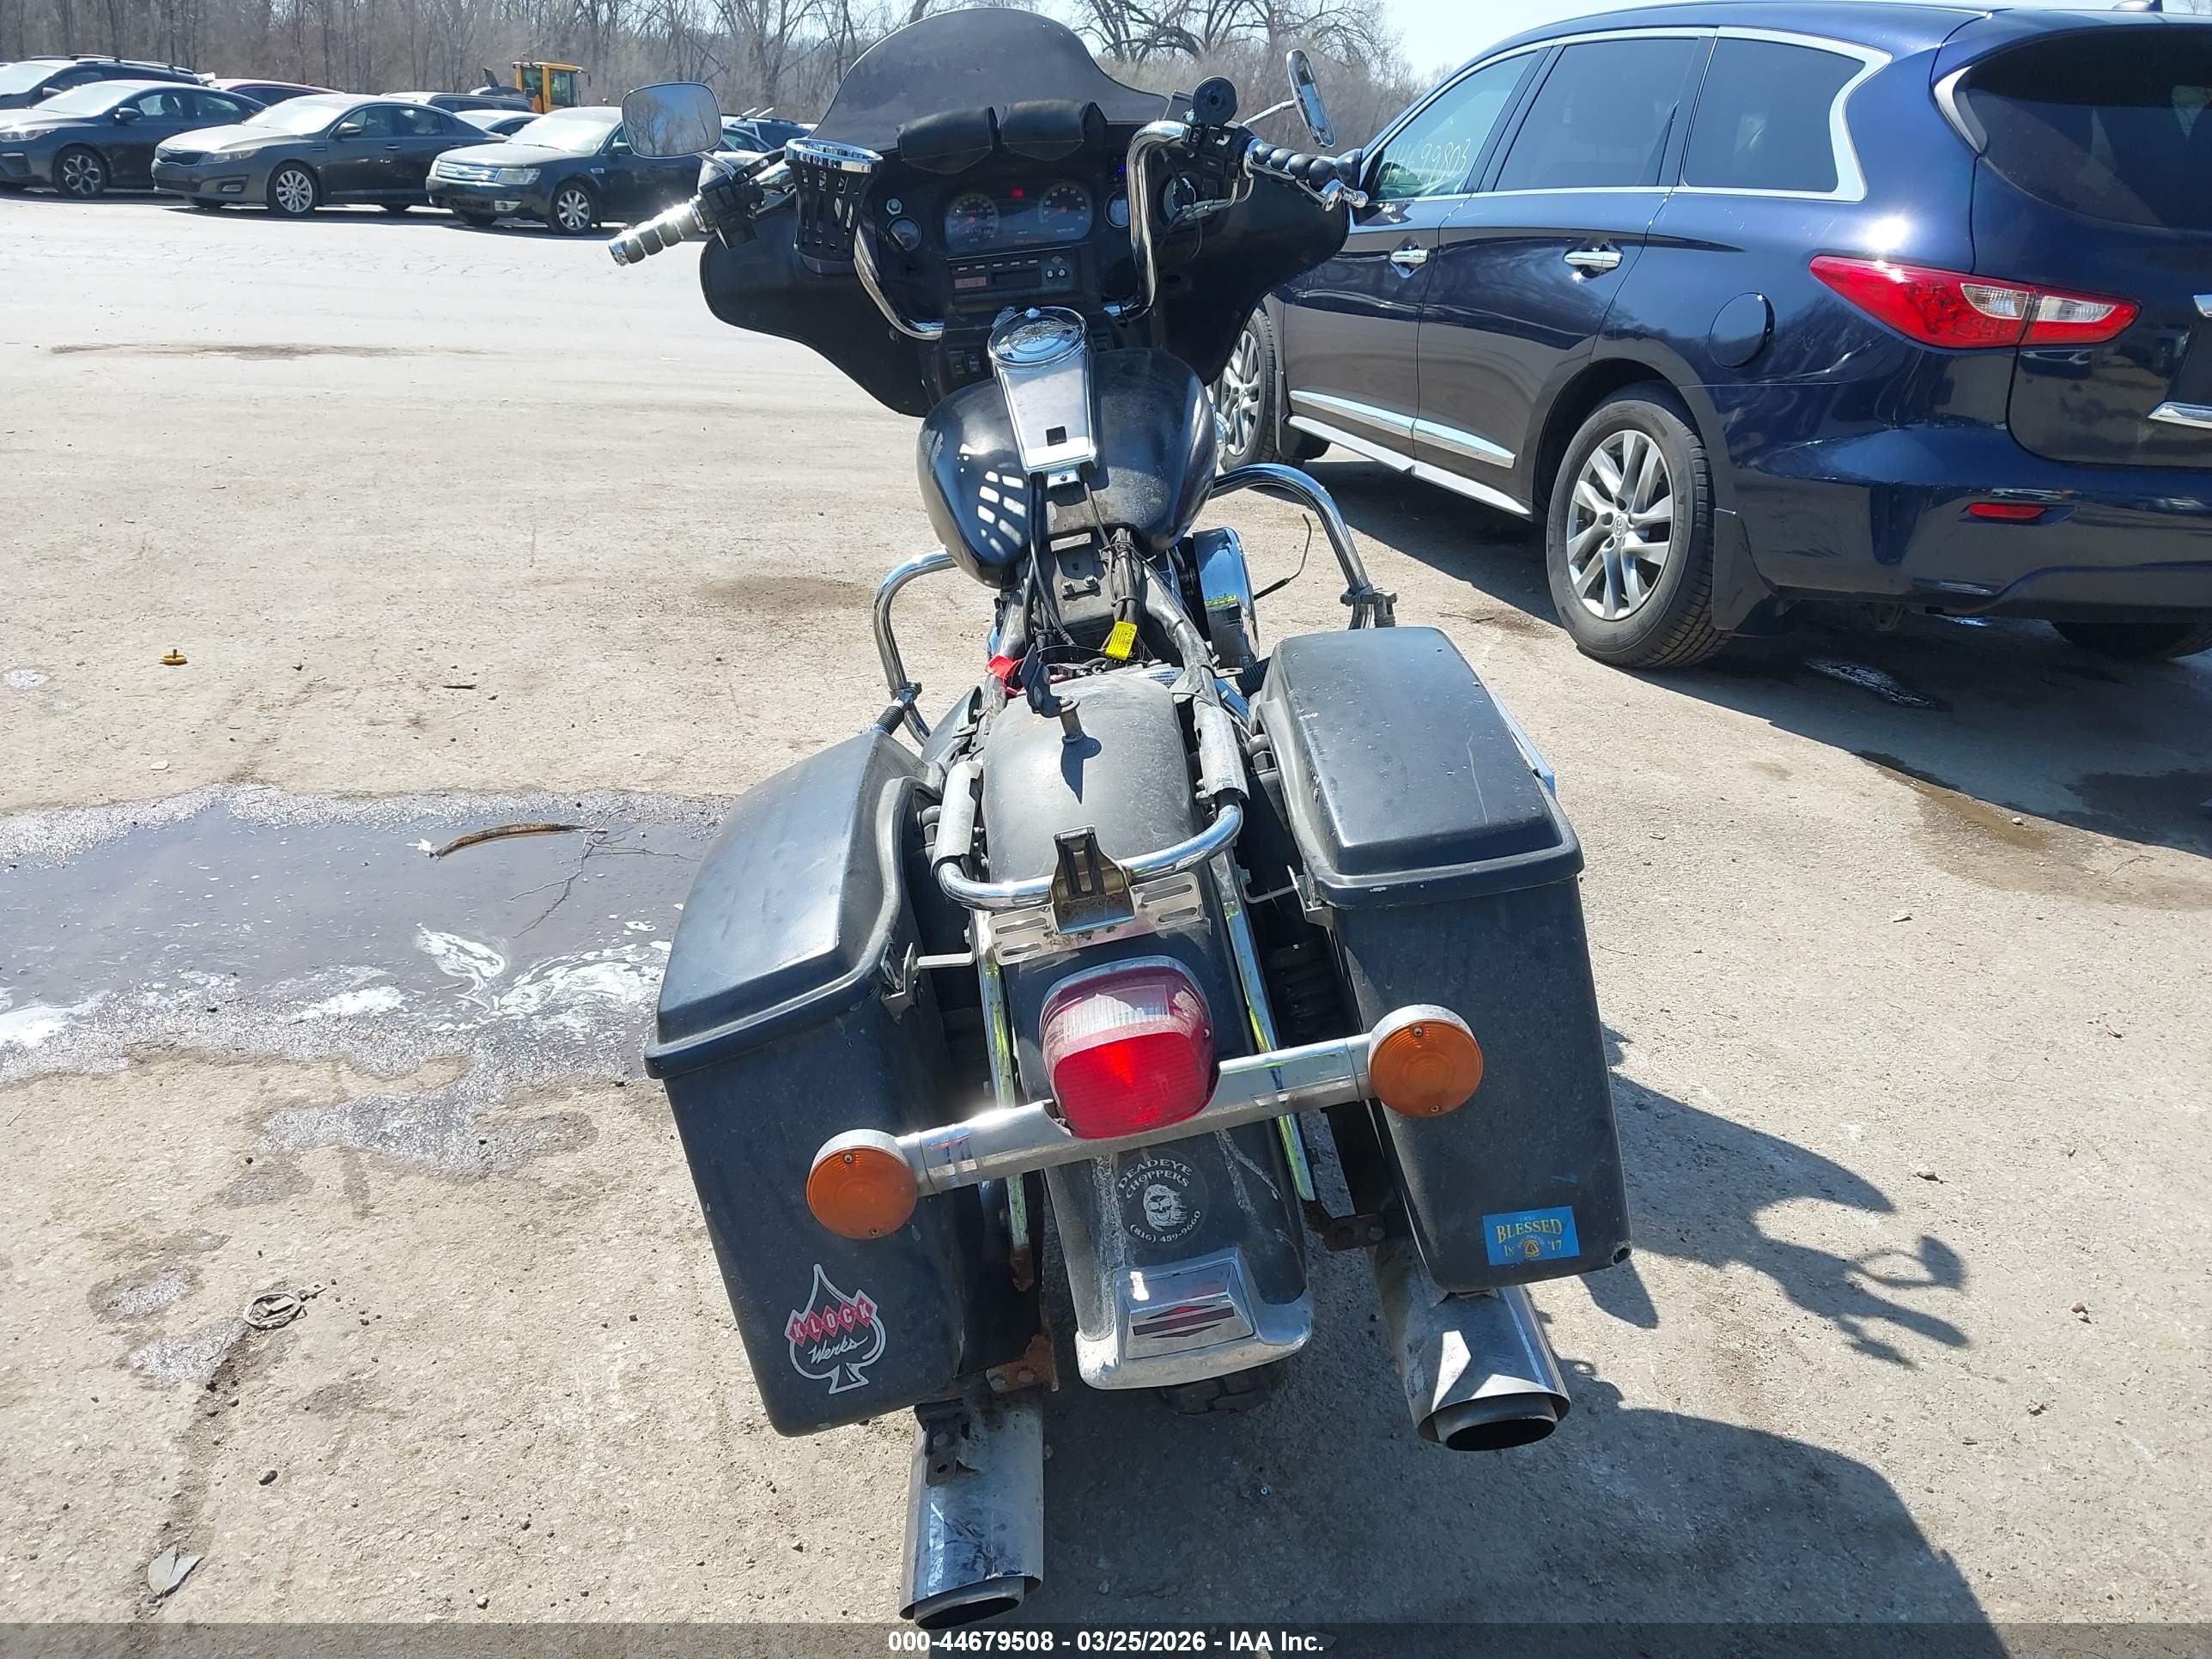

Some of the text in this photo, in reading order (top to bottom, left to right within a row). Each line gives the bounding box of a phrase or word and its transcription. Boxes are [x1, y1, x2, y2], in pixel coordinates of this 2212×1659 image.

[1118, 1158, 1193, 1189] DEADEYE
[1126, 1170, 1189, 1199] CHOPPERS
[1130, 1210, 1201, 1243] (816) 459-9660
[1496, 1218, 1563, 1243] BLESSED
[793, 1303, 870, 1338] KLOCK
[807, 1334, 868, 1364] Werks
